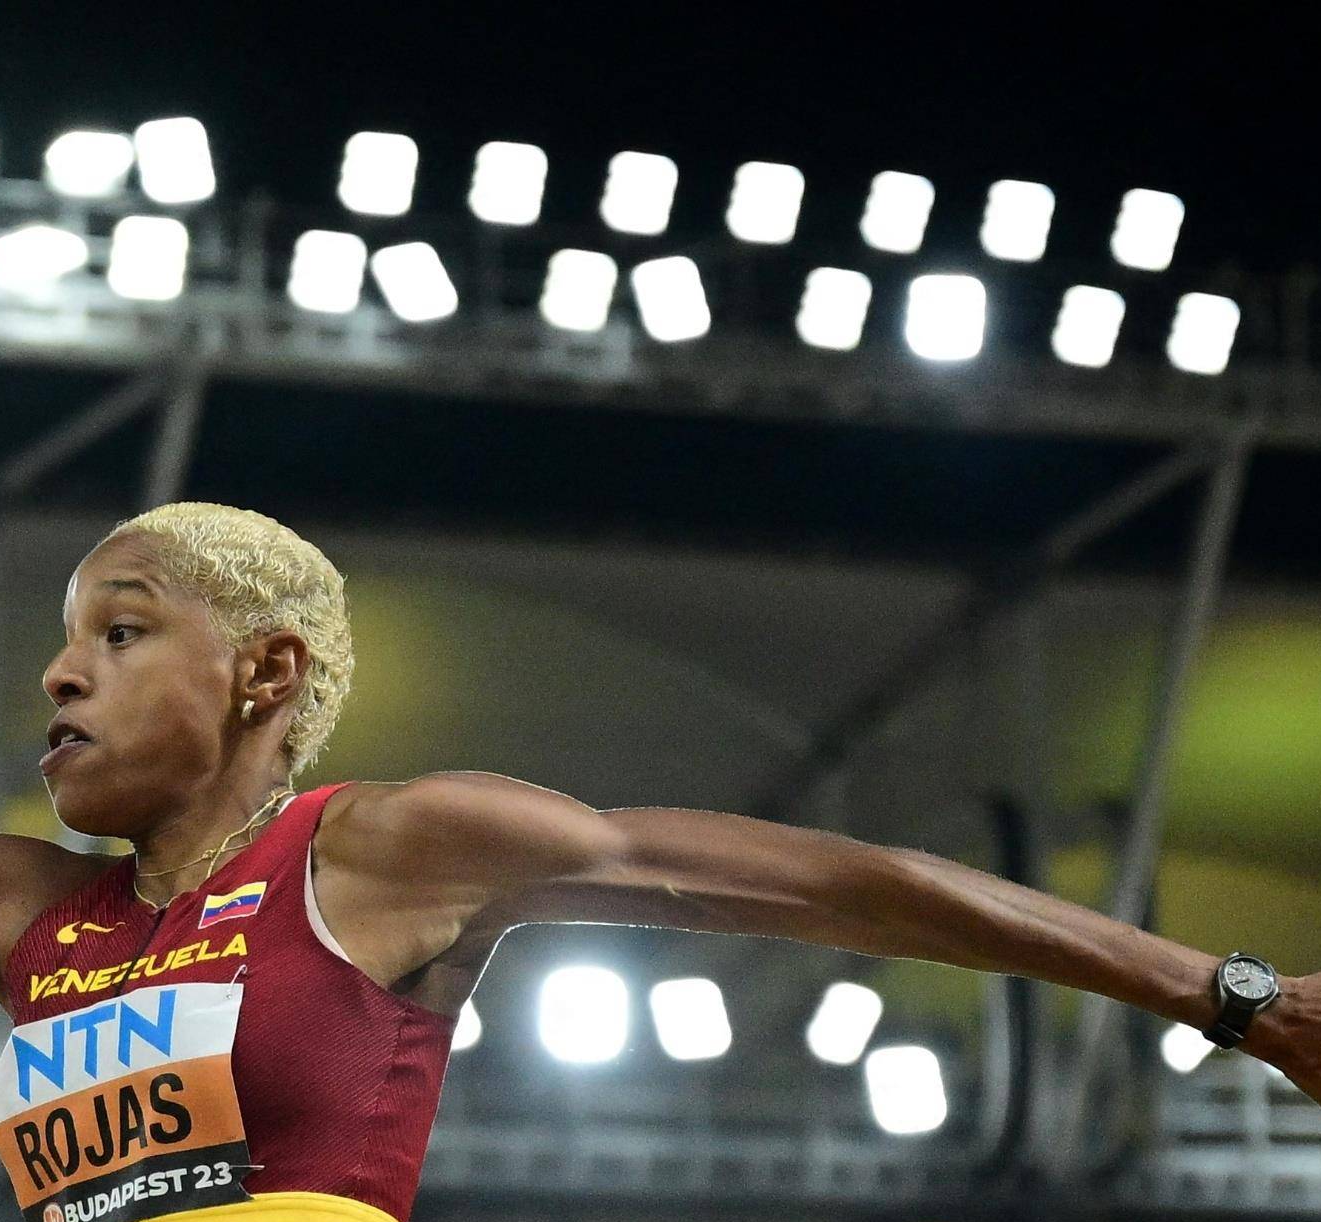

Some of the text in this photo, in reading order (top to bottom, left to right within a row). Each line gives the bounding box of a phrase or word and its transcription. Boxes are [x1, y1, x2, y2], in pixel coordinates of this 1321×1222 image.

[30, 933, 248, 1002] VENEZUELA
[12, 989, 177, 1103] NTN
[14, 1072, 192, 1191] ROJAS
[192, 1161, 233, 1190] 23
